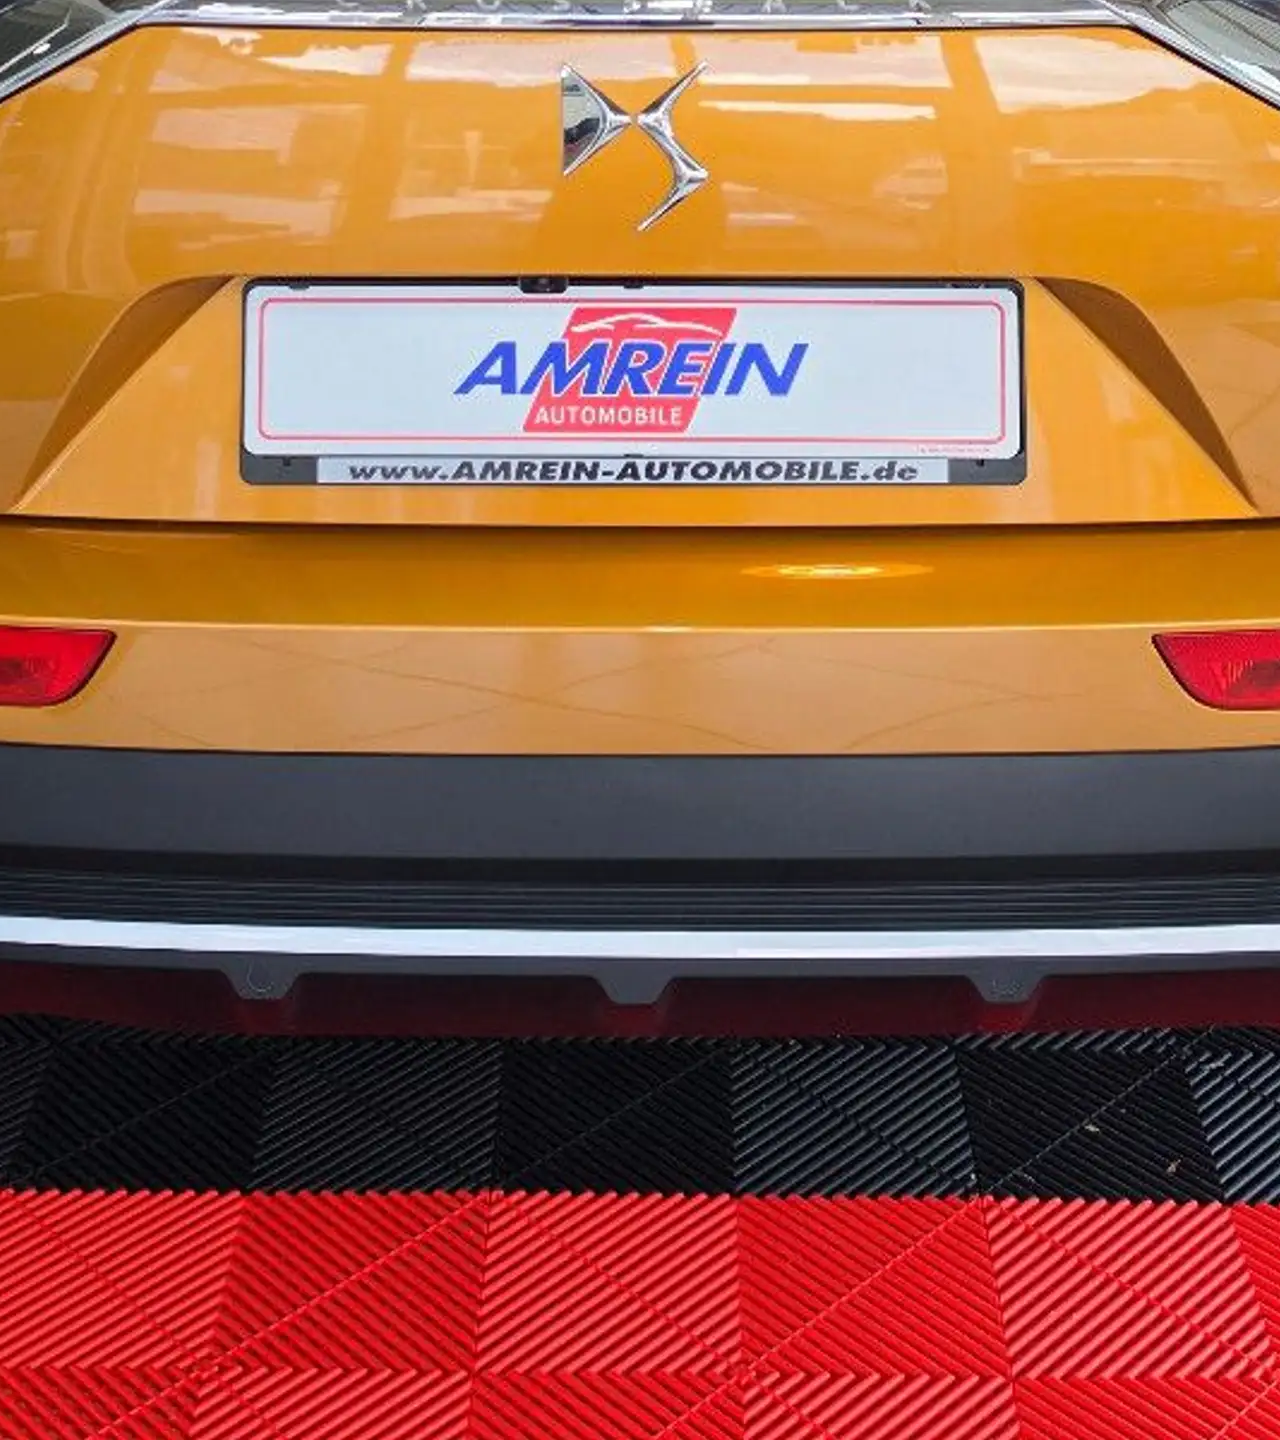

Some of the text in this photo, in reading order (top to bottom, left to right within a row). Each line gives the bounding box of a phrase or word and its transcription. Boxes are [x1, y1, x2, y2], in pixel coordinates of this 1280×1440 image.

[453, 340, 810, 397] AMREIN
[534, 404, 684, 427] AUTOMOBILE
[347, 459, 920, 483] www.AMREIN-AUTOMOBILE.de
